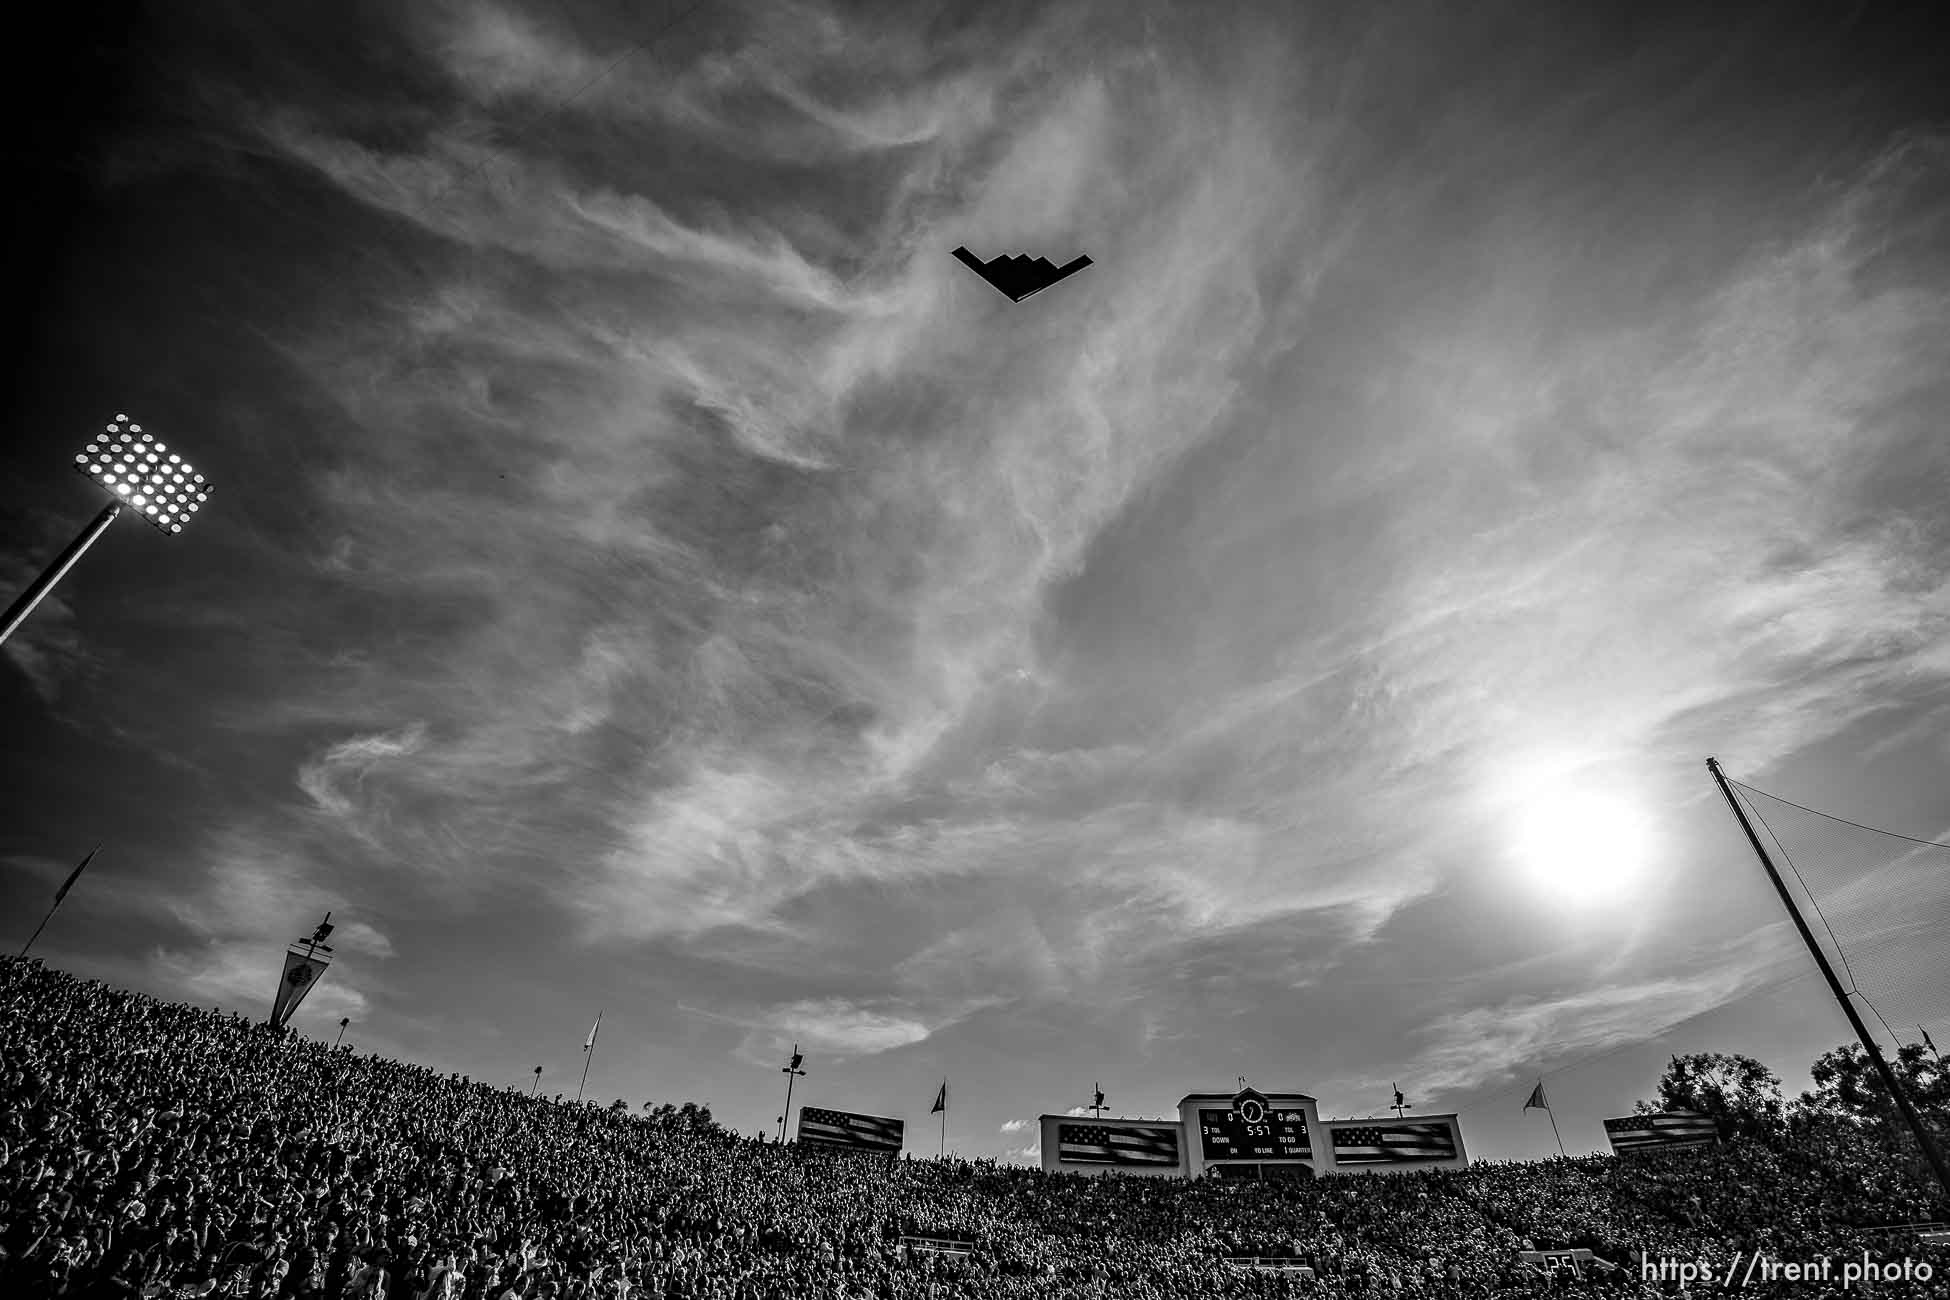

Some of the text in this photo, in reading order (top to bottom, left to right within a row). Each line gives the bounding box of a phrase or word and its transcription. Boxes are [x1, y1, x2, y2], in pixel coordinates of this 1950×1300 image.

[1203, 1126, 1208, 1134] 3
[1247, 1125, 1270, 1136] 5:57
[1301, 1125, 1306, 1134] 3
